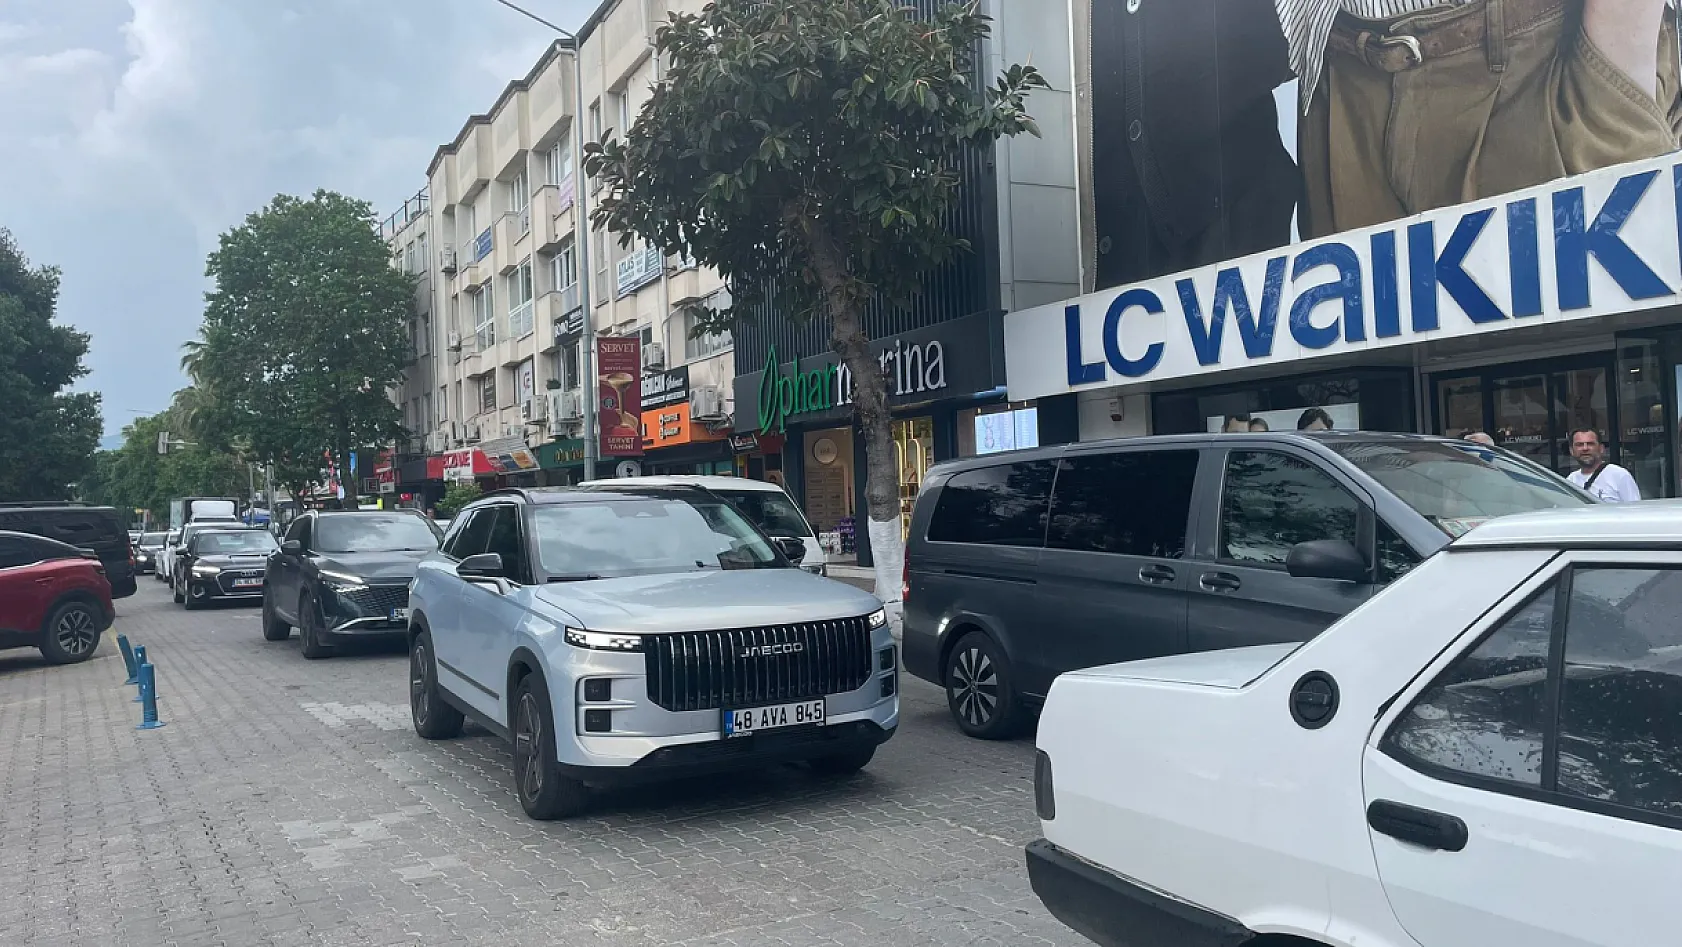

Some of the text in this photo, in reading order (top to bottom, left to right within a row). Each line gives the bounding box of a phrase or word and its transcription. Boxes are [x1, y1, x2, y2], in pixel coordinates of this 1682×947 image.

[600, 341, 635, 353] SERVET
[1065, 288, 1165, 386] LC
[740, 642, 804, 658] JAECOO
[734, 710, 753, 730] 48
[760, 706, 788, 727] AVA
[796, 702, 822, 722] 845
